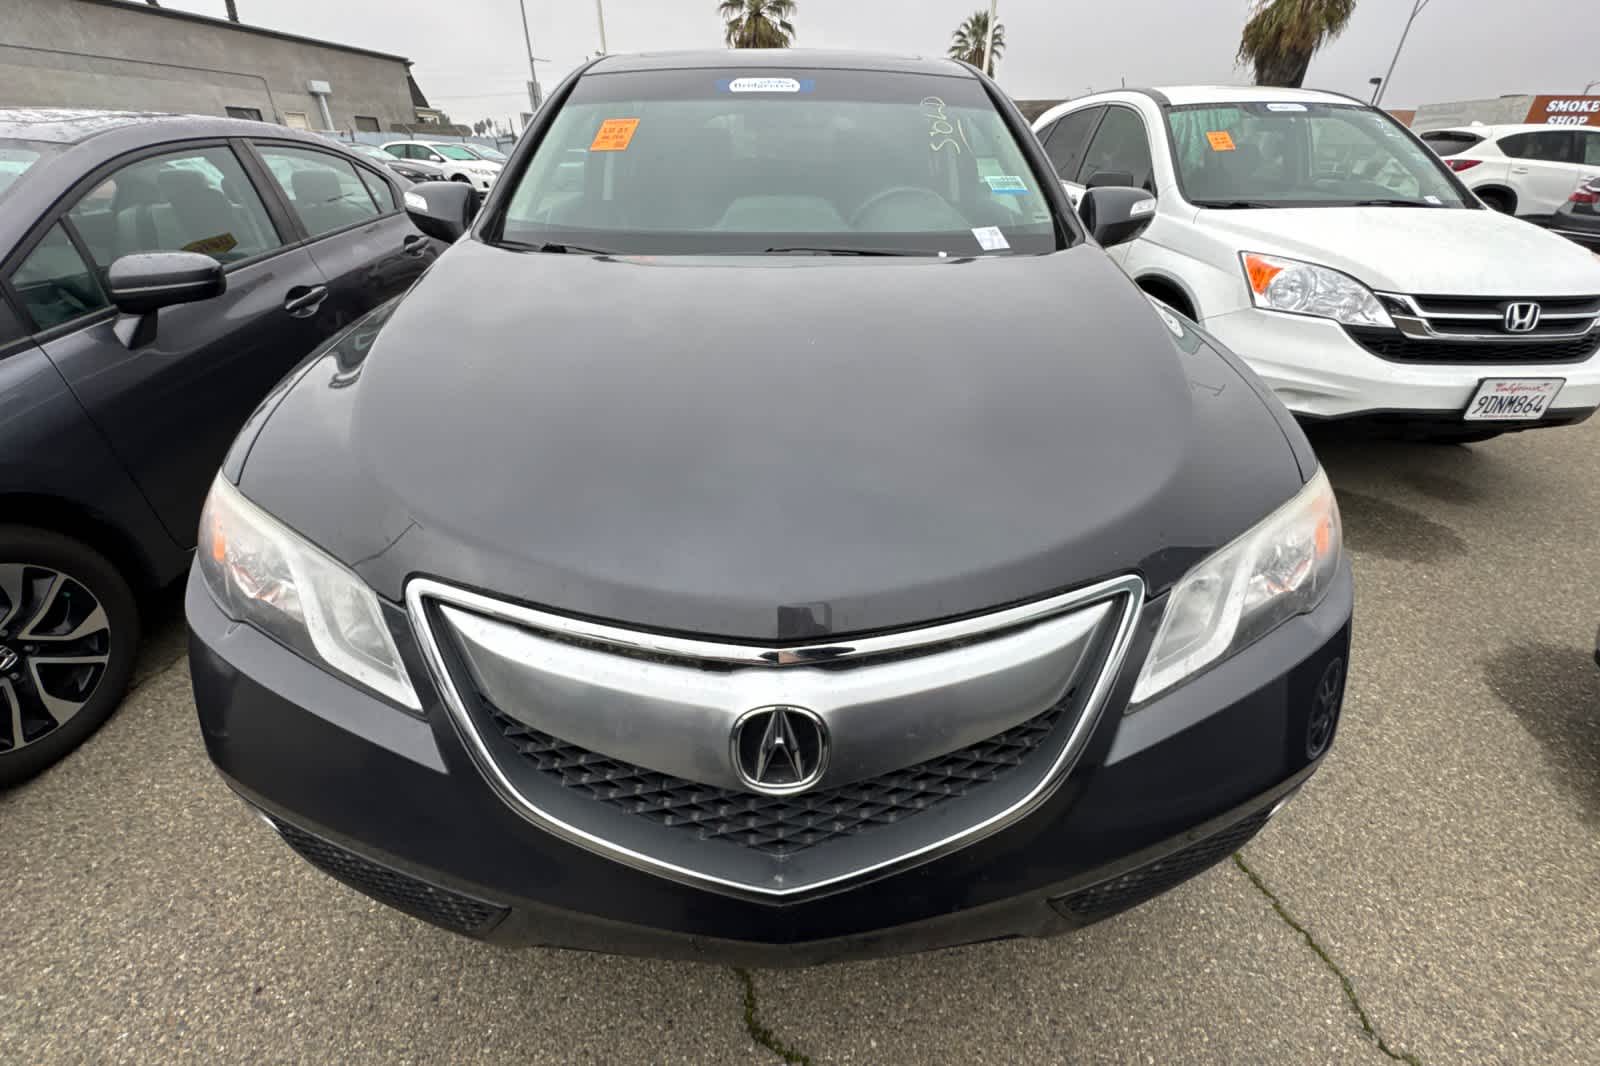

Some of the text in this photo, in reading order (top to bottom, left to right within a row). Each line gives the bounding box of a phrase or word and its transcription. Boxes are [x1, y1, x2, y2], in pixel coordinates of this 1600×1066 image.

[1545, 100, 1600, 113] SMOKE
[1547, 115, 1589, 126] SHOP
[1472, 394, 1547, 415] 9DNM864
